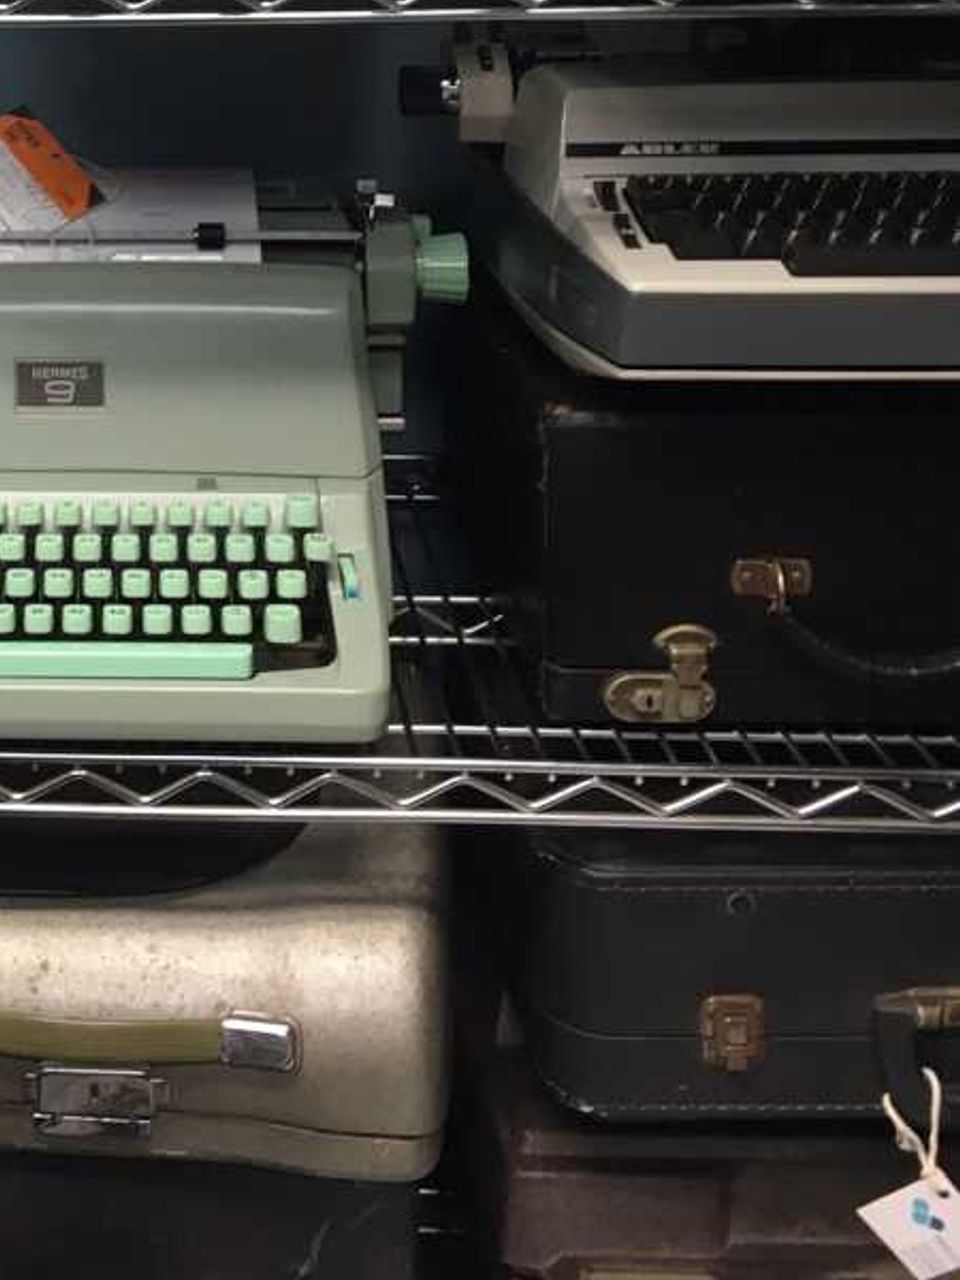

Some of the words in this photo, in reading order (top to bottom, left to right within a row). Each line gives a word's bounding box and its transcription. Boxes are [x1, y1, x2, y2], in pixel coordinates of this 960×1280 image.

[620, 142, 721, 155] ADLER
[31, 364, 89, 379] HERMES
[43, 379, 76, 404] 9
